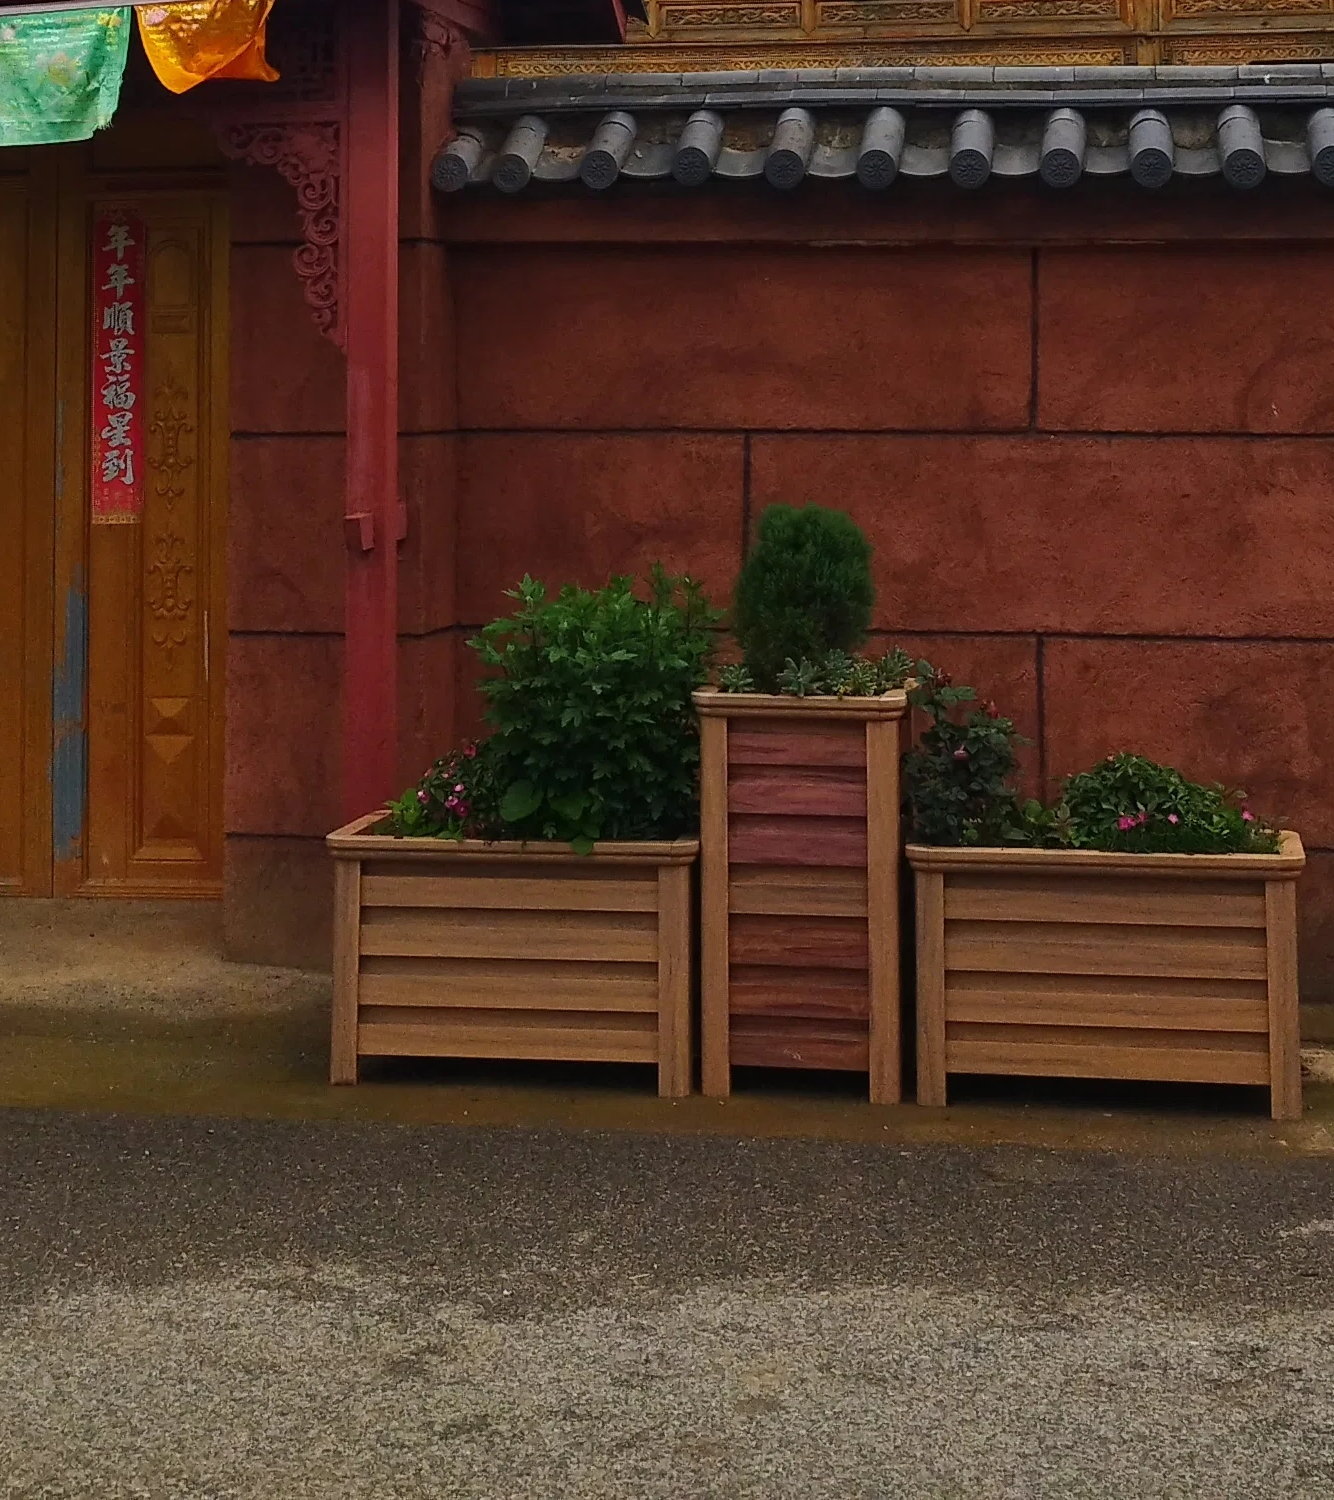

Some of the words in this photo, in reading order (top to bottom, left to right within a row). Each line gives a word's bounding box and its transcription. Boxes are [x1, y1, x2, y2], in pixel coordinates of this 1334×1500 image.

[100, 223, 137, 486] 年年順景福星到
